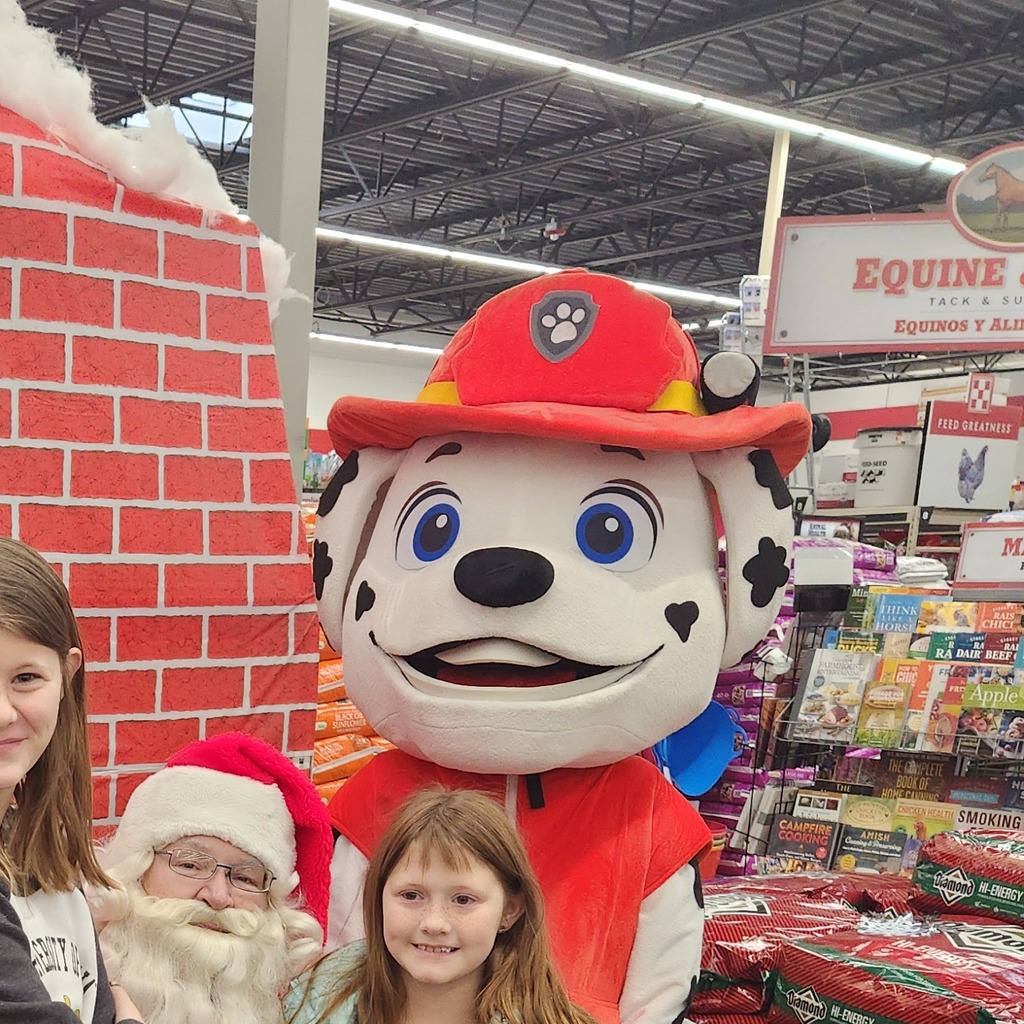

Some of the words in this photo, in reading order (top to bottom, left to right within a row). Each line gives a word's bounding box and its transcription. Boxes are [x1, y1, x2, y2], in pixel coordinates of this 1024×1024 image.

[853, 258, 1006, 295] EQUINE
[930, 296, 970, 306] TACK
[982, 296, 990, 305] &
[894, 319, 968, 335] EQUINOS
[975, 319, 985, 331] Y
[937, 418, 959, 430] FEED
[962, 420, 1011, 434] GREATNESS
[1001, 537, 1024, 556] M
[880, 604, 918, 615] THINK
[982, 620, 1014, 630] CHIC
[956, 649, 983, 659] DAIR
[985, 650, 1013, 661] BEEF
[969, 684, 1018, 708] Apple
[888, 759, 902, 773] THE
[904, 760, 944, 777] COMPLETE
[836, 783, 851, 793] THE
[897, 775, 917, 788] BOOK
[919, 777, 929, 790] OF
[898, 804, 926, 816] CHICKEN
[928, 808, 955, 819] HEALTH
[958, 809, 1022, 830] SMOKING
[779, 819, 833, 836] CAMPFIRE
[778, 830, 828, 846] COOKING
[860, 830, 890, 842] AMISH
[935, 872, 974, 895] Diamond
[979, 881, 1024, 902] HI-ENERGY
[788, 990, 826, 1019] Diamond
